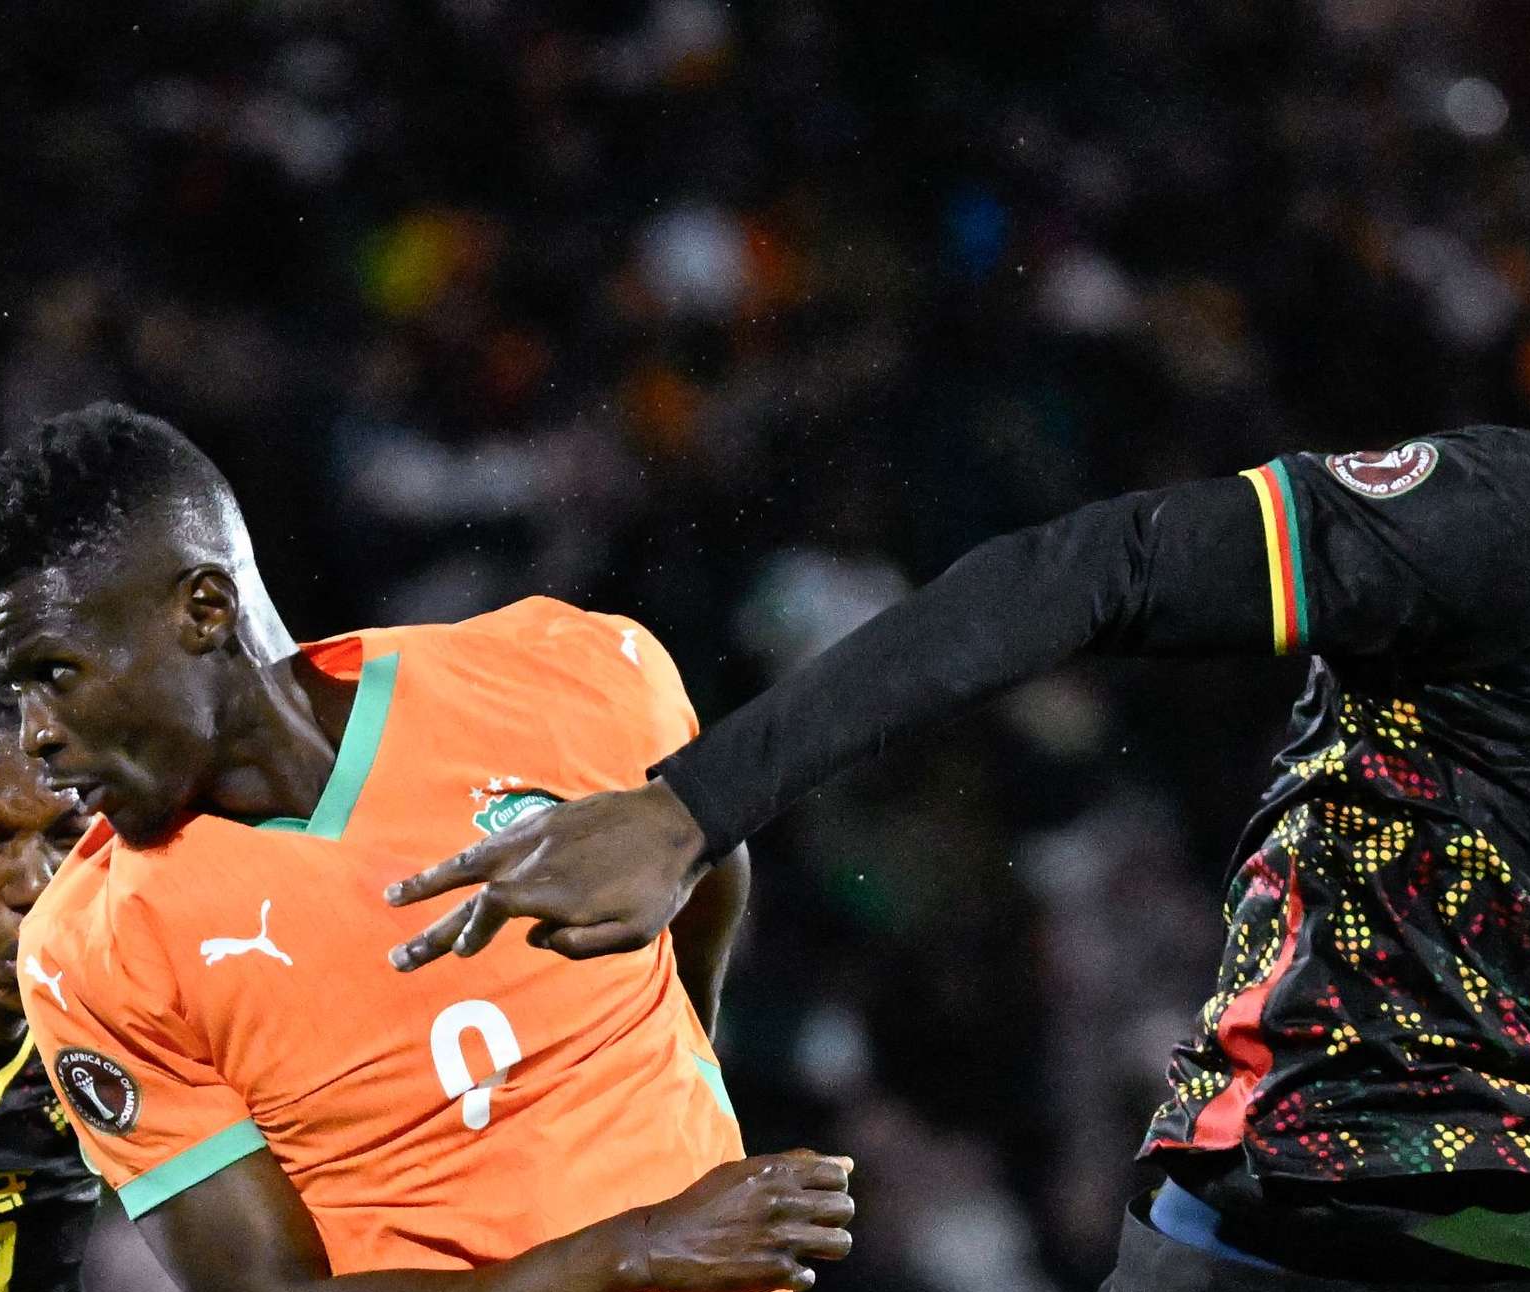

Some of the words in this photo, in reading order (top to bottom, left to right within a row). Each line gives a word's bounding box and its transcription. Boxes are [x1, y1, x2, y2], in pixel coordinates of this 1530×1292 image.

[1372, 483, 1389, 494] OF
[1390, 474, 1412, 490] CUP
[69, 1052, 101, 1067] AFRICA
[103, 1061, 123, 1077] CUP
[120, 1077, 134, 1092] OF
[431, 999, 522, 1131] 9
